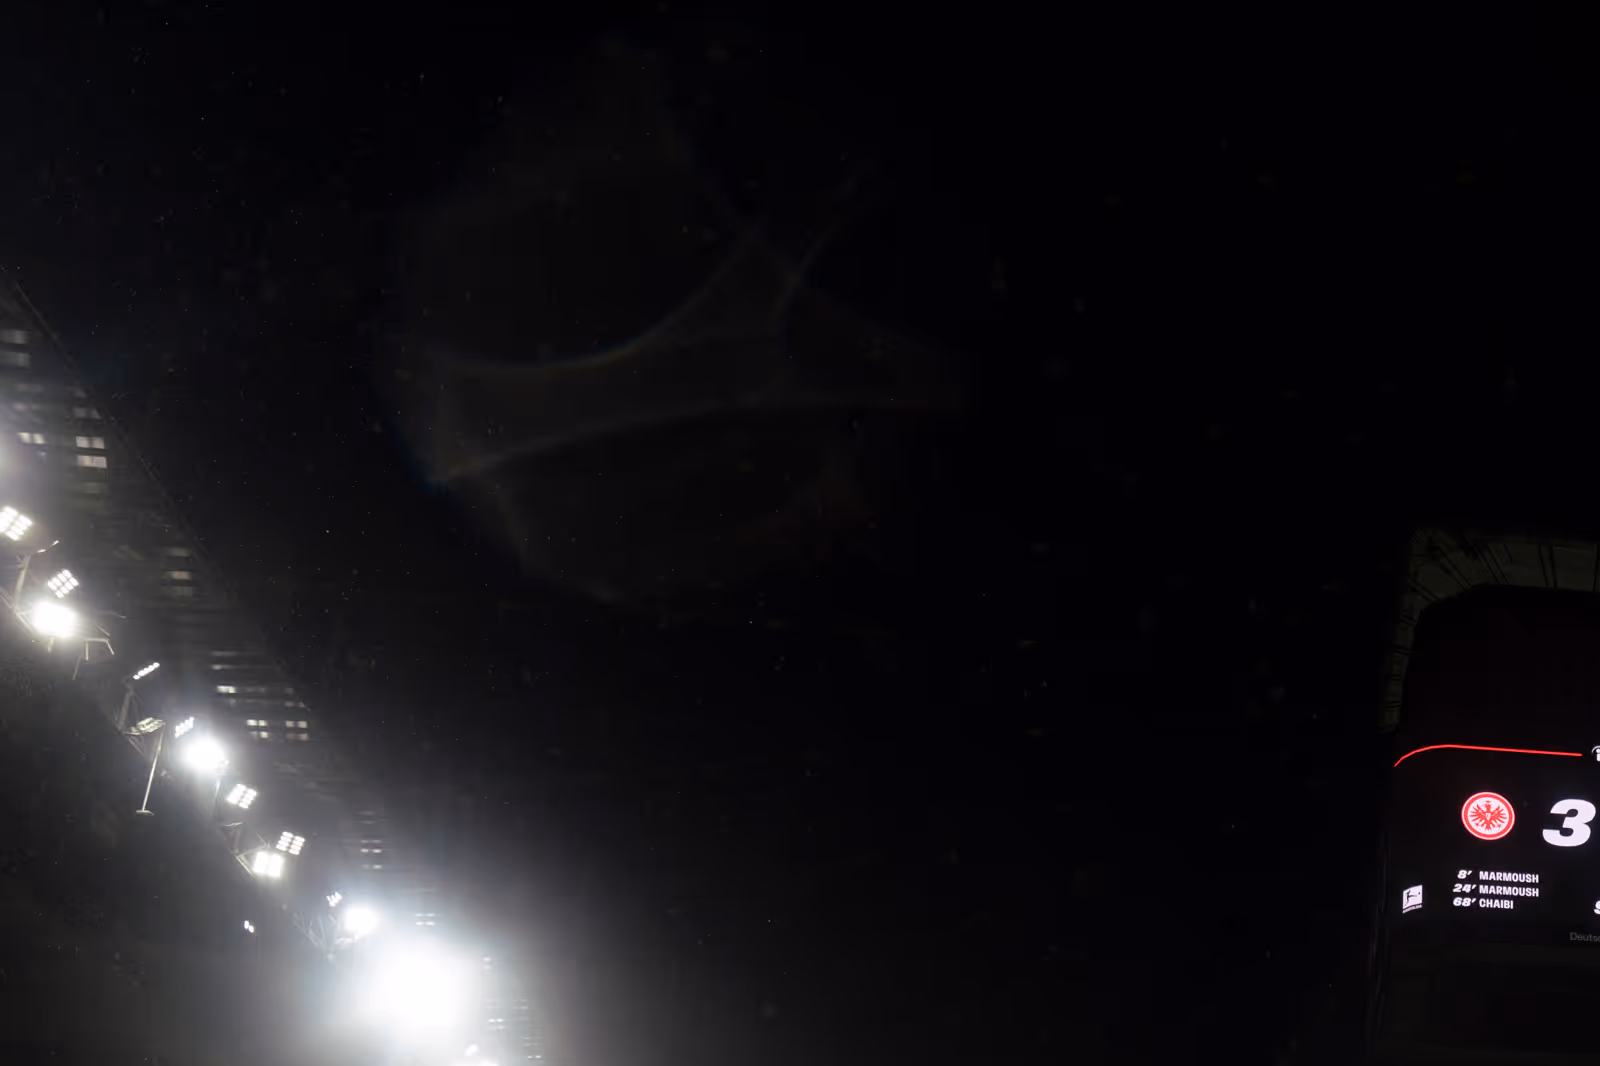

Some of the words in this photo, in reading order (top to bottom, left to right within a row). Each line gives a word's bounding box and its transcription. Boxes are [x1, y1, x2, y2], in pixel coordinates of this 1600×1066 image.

[1543, 799, 1596, 847] 3
[1479, 871, 1539, 883] MARMOUSH
[1479, 885, 1539, 897] MARMOUSH
[1479, 898, 1513, 909] CHAIBI
